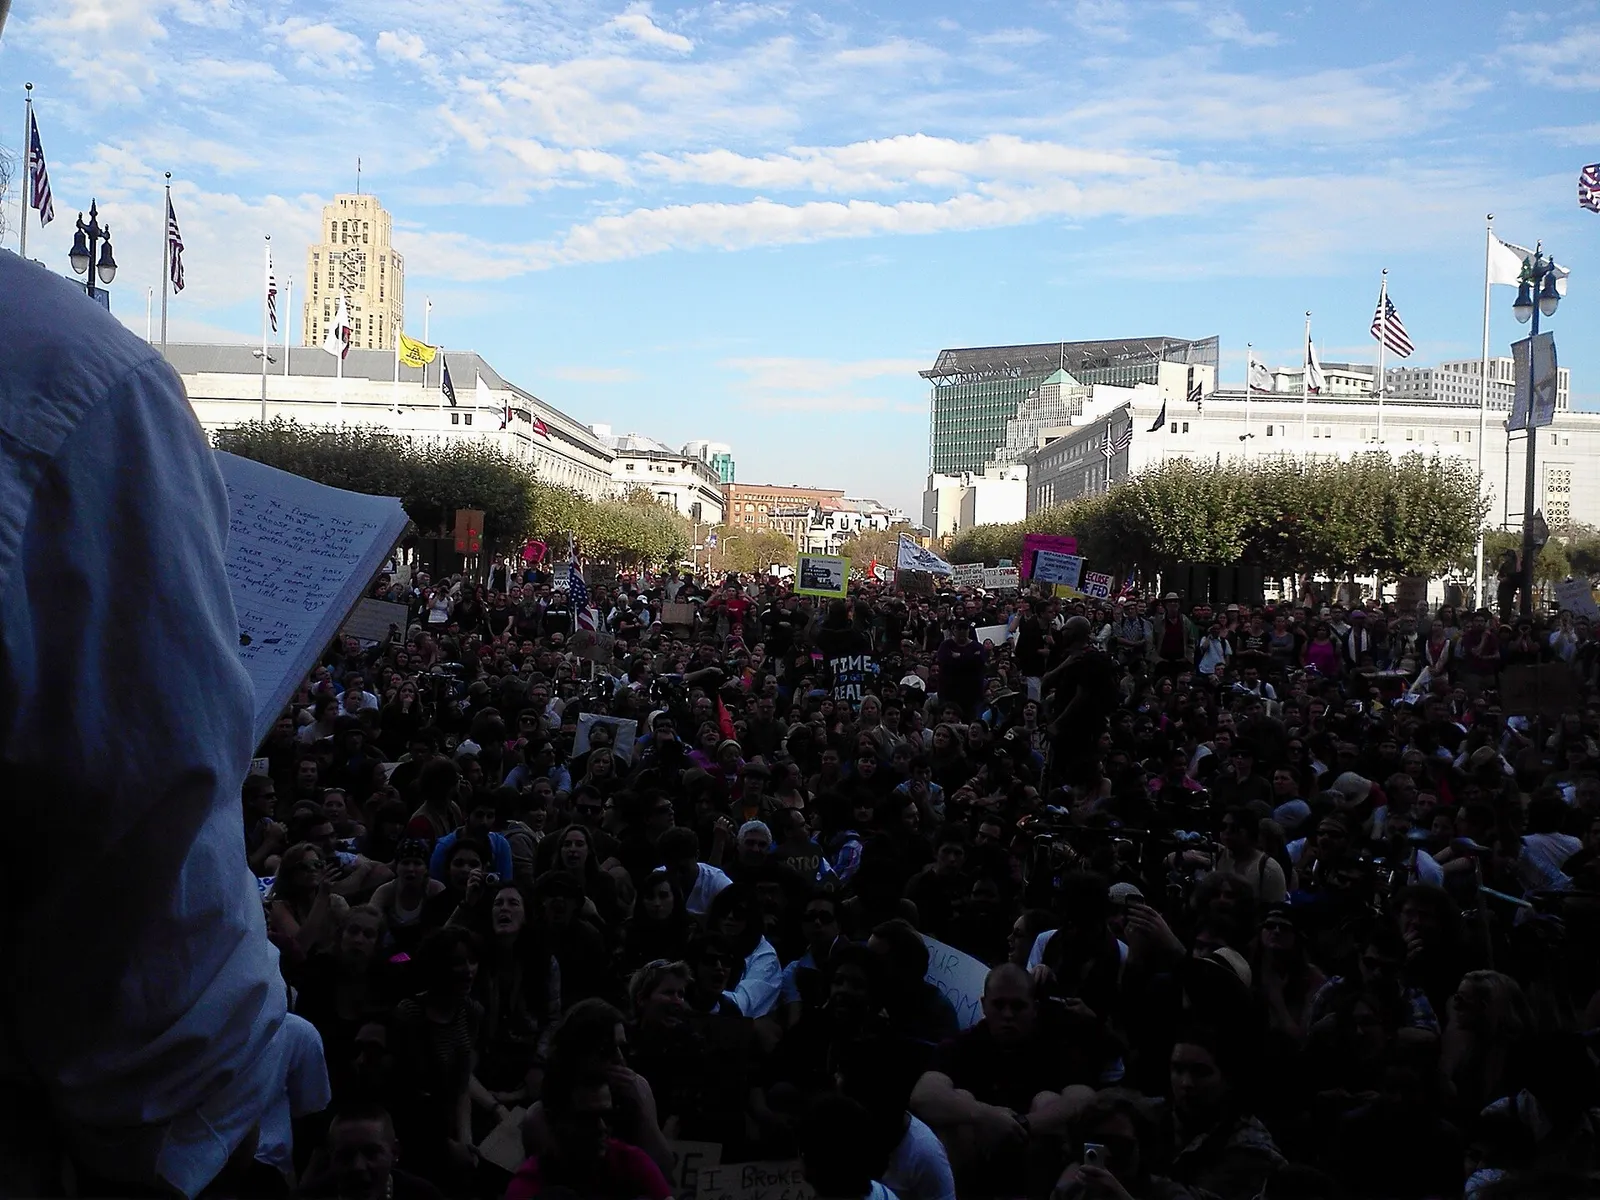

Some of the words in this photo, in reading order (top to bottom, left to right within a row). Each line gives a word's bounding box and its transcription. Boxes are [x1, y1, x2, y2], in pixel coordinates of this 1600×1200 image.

[811, 514, 879, 531] RUTH
[1085, 571, 1110, 585] ECLOSE
[1091, 585, 1109, 598] FED
[830, 654, 873, 675] TIME
[834, 683, 866, 701] REAL
[740, 1165, 804, 1190] BROKE
